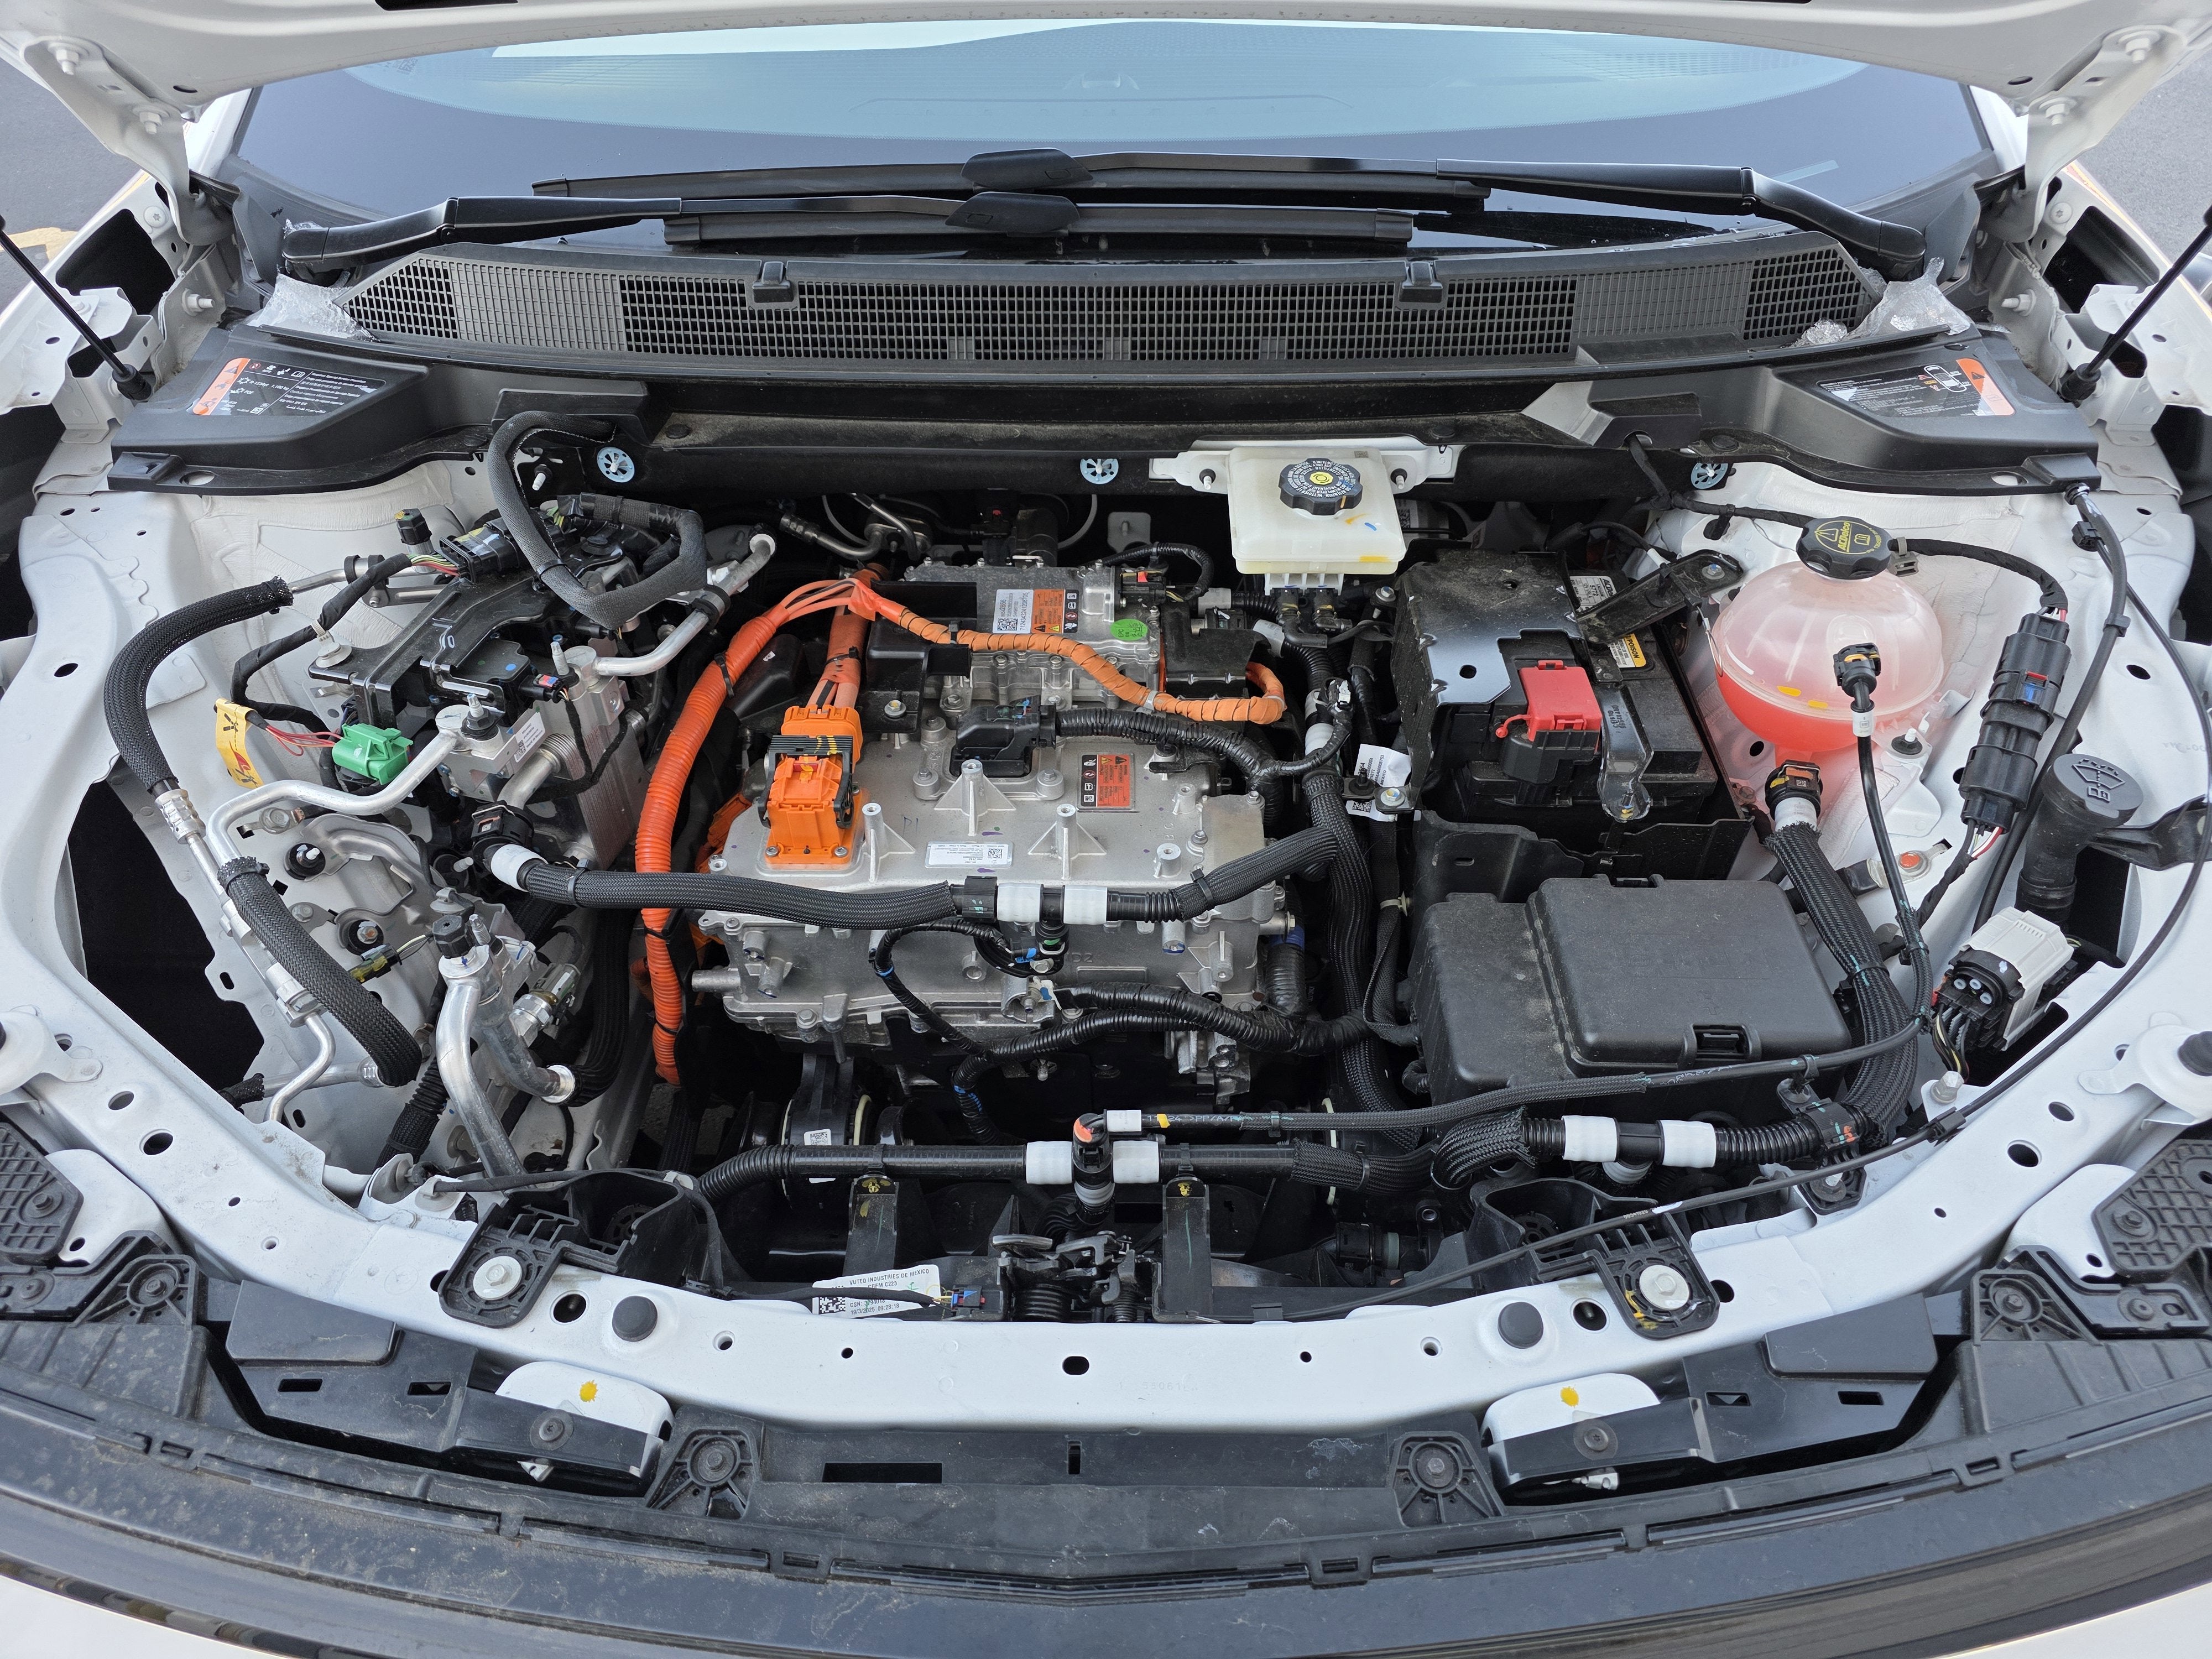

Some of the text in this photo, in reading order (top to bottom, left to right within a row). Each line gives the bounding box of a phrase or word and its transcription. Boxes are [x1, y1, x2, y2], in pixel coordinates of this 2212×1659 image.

[1837, 521, 1851, 551] ACDelco
[1589, 585, 1599, 596] 5772
[910, 1269, 929, 1277] MEXICO
[851, 1303, 900, 1315] 19/3/2025 09:28:18
